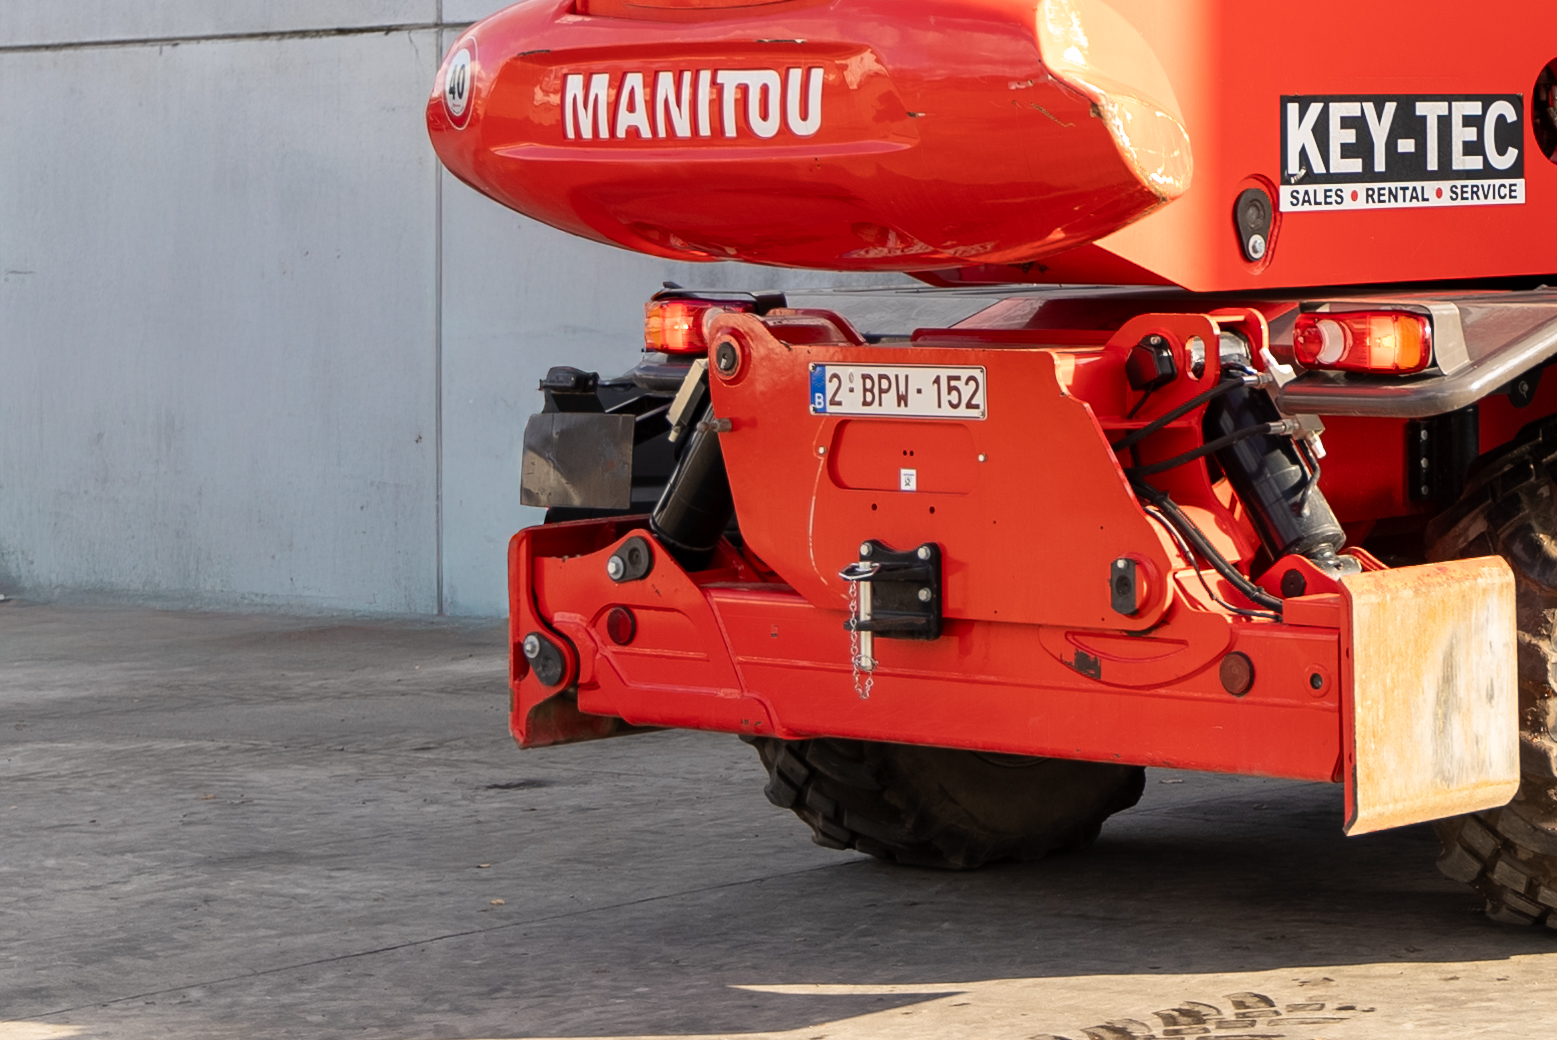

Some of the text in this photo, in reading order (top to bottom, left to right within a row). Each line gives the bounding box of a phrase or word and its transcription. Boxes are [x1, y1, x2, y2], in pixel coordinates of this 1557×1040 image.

[448, 64, 466, 100] 40
[564, 67, 824, 139] MANITOU
[1286, 100, 1519, 175] KEY-TEC
[1290, 183, 1518, 207] SALES RENTAL SERVICE
[814, 393, 825, 409] B
